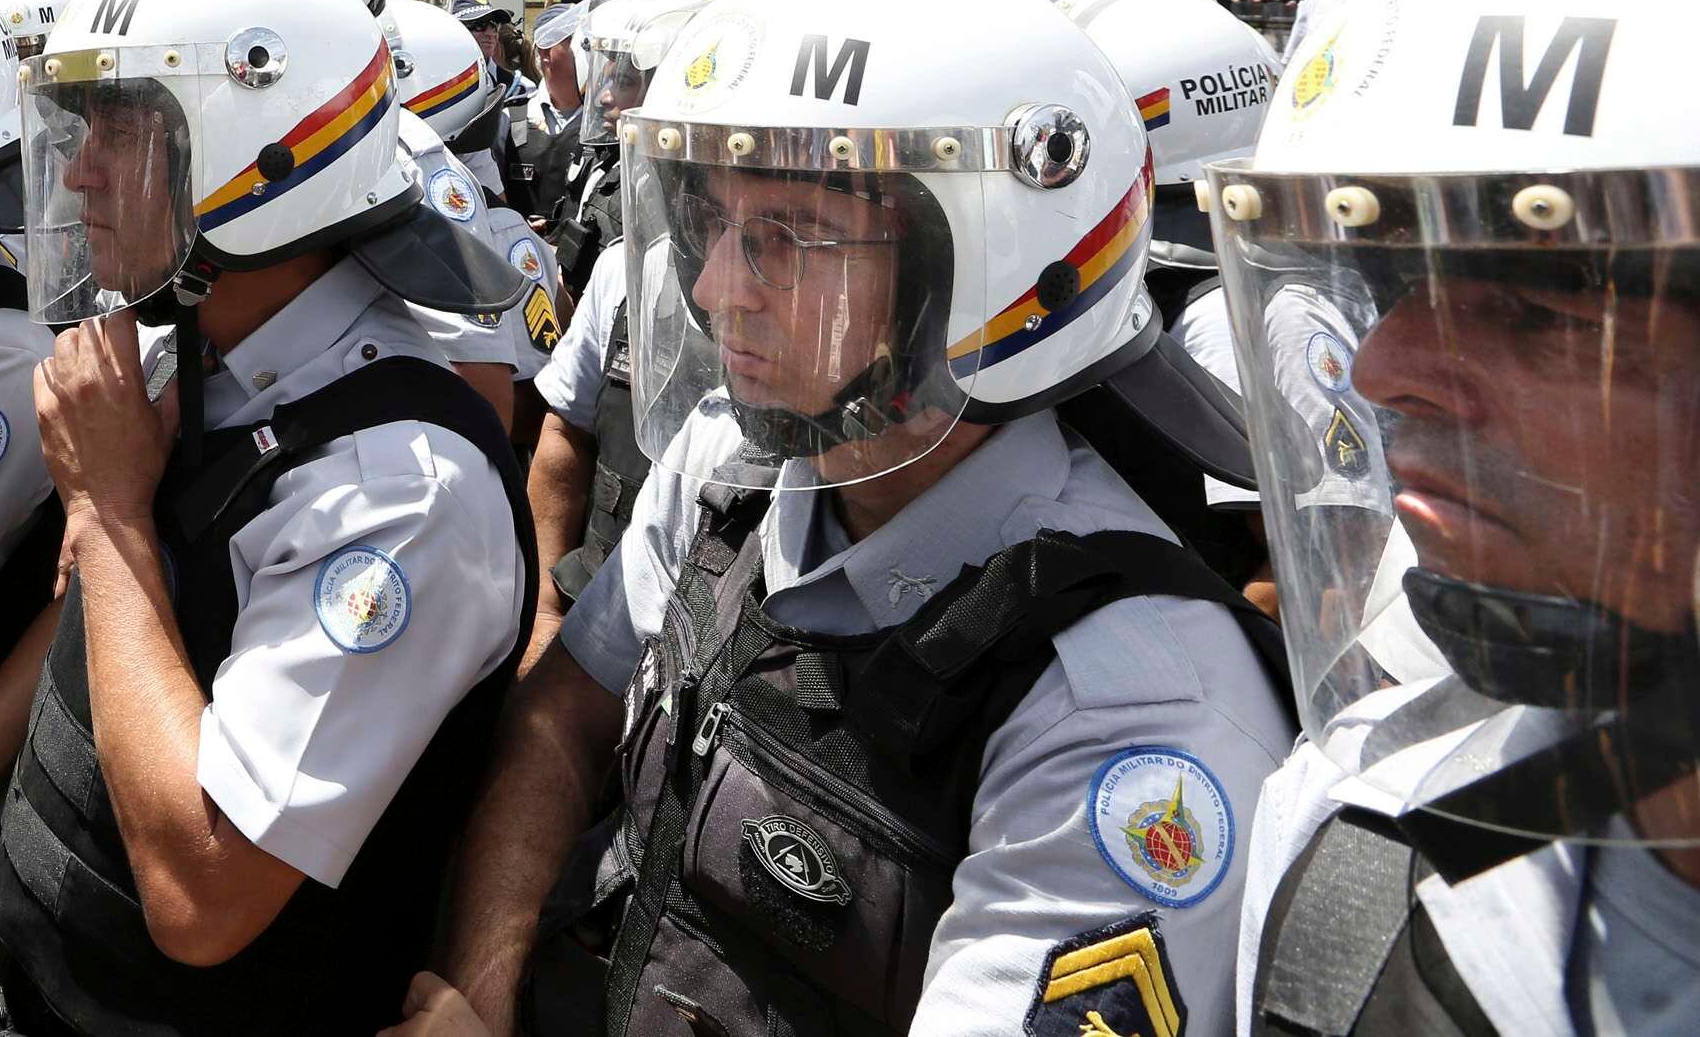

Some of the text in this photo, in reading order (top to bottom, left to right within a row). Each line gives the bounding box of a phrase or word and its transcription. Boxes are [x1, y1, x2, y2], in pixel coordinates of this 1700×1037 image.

[39, 6, 55, 24] M
[789, 34, 871, 107] M
[1180, 64, 1269, 100] POLÍCIA
[1195, 86, 1268, 116] MILITAR
[1452, 15, 1618, 137] M
[334, 555, 364, 575] MILITAR
[379, 597, 403, 636] FEDERAL
[1101, 756, 1226, 860] POLÍCIA MILITAR DO DISTRITO FEDERAL
[765, 822, 787, 832] TIRO
[789, 824, 834, 873] DEFENSIVO
